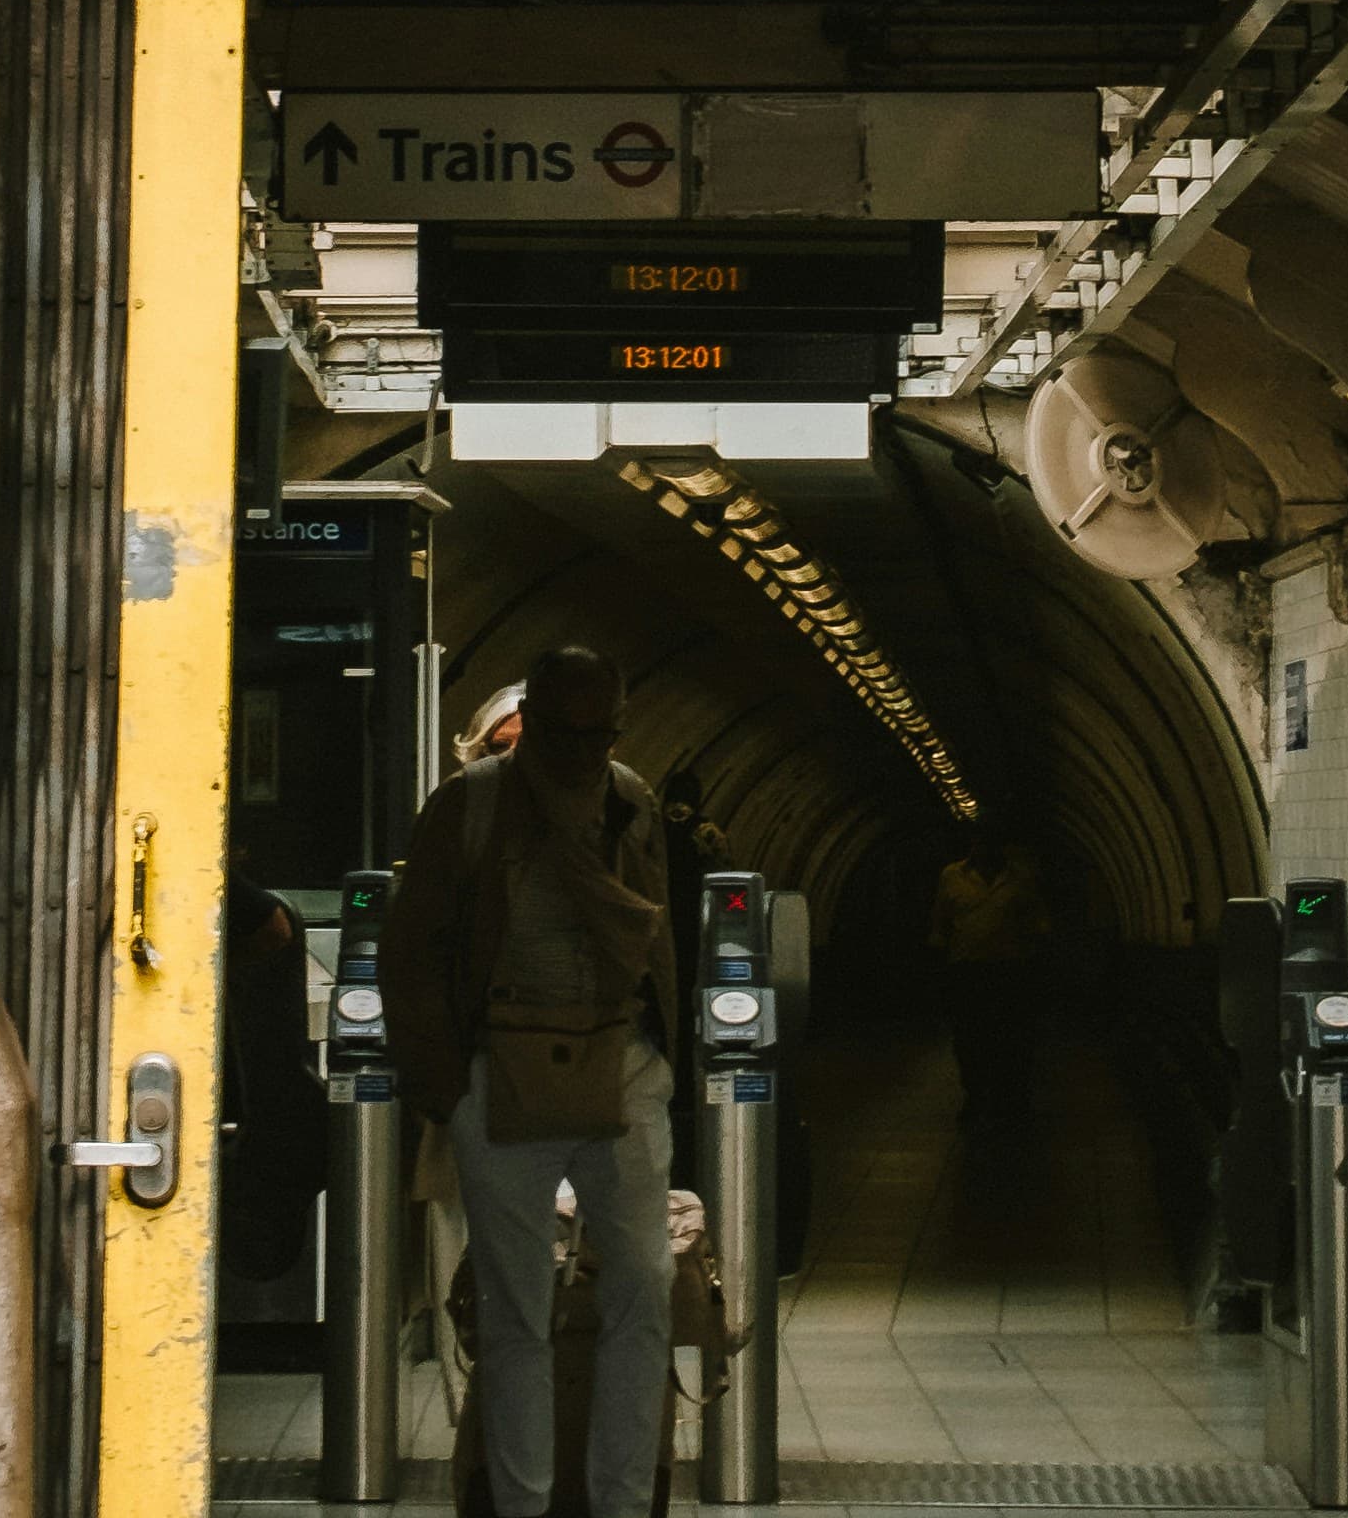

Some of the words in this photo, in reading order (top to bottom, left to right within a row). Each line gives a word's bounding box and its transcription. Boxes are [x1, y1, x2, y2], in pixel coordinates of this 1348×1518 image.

[378, 128, 575, 183] Trains
[627, 265, 740, 292] 13:12:01
[623, 346, 722, 369] 13:12:01
